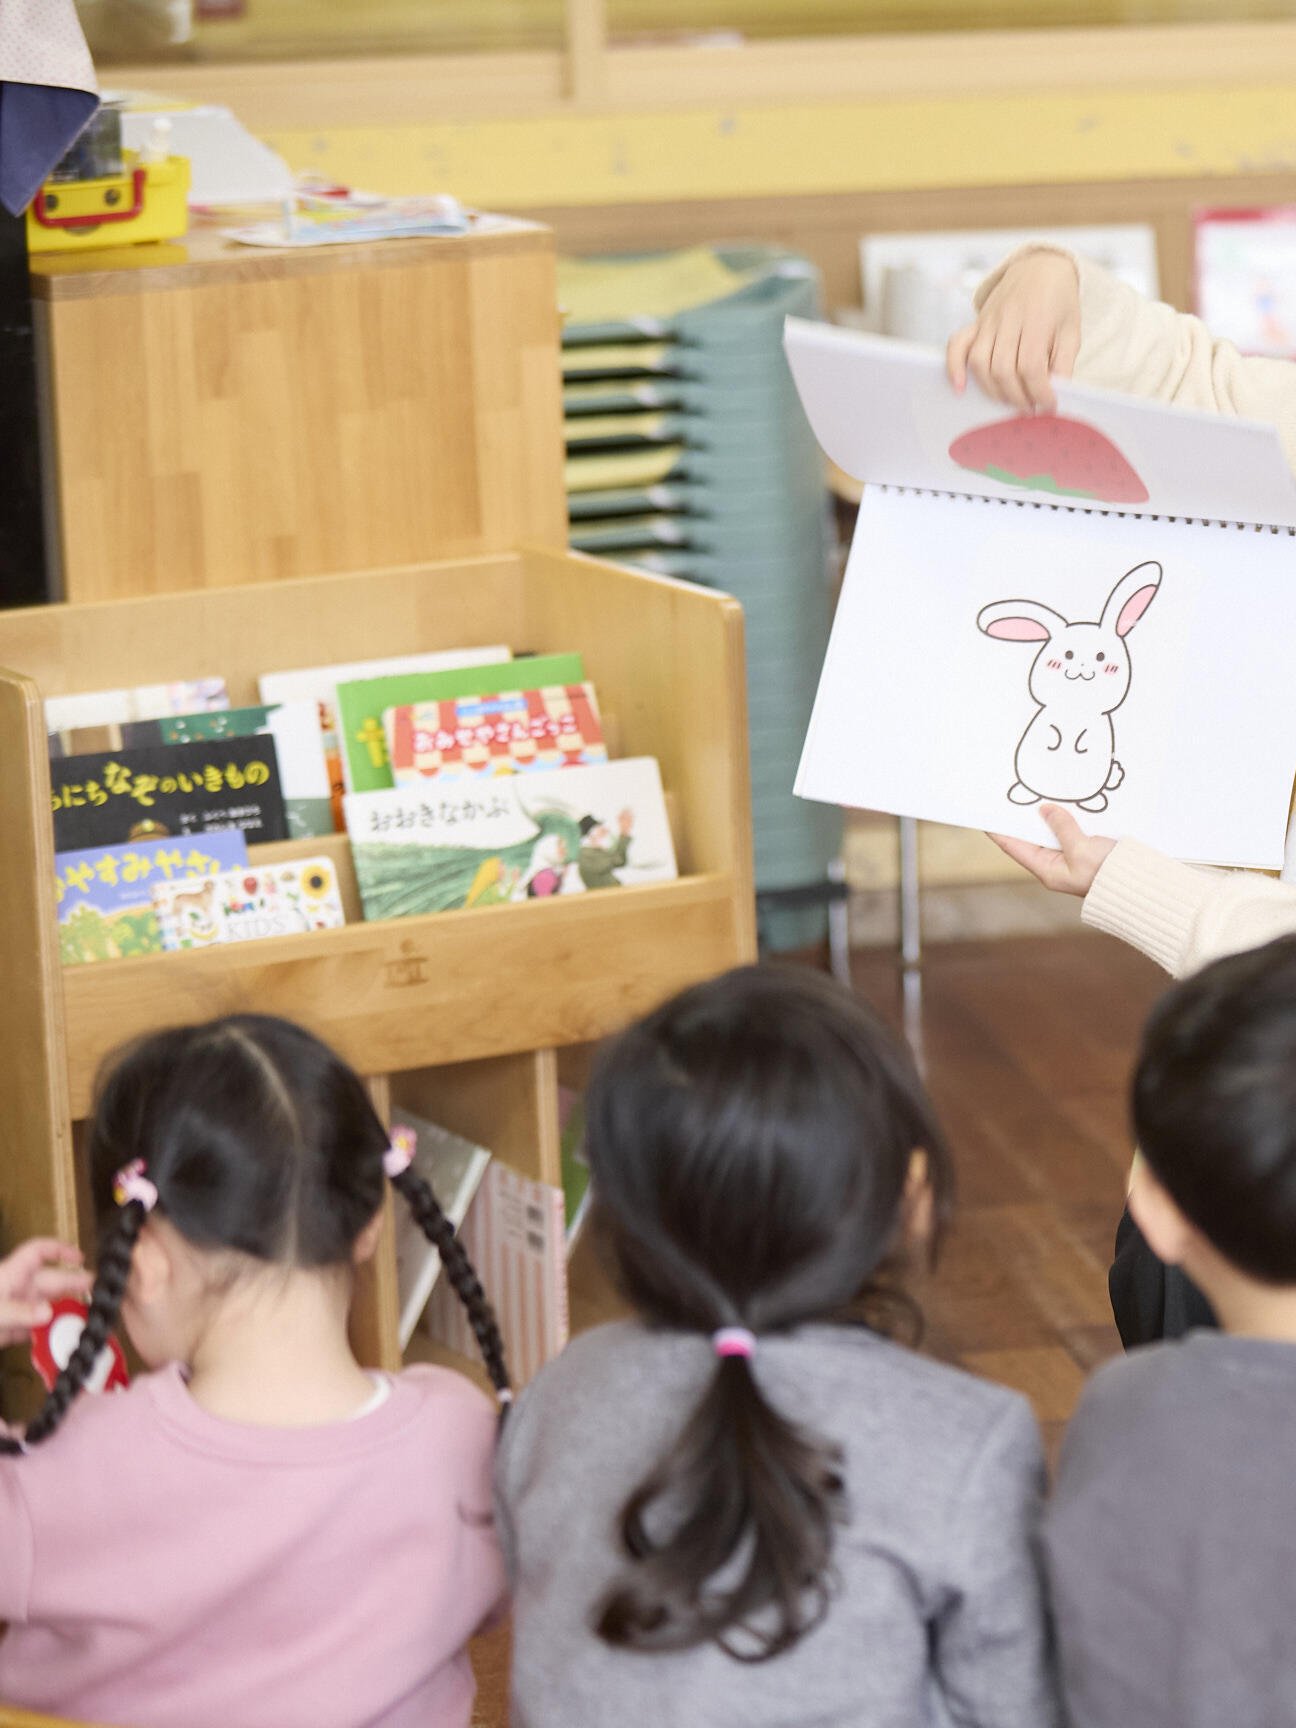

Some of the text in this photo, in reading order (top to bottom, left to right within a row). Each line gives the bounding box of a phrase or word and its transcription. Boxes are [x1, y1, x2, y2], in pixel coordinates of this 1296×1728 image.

[414, 713, 577, 752] おみせやさんごっこ
[371, 797, 511, 833] おおきなかぶ
